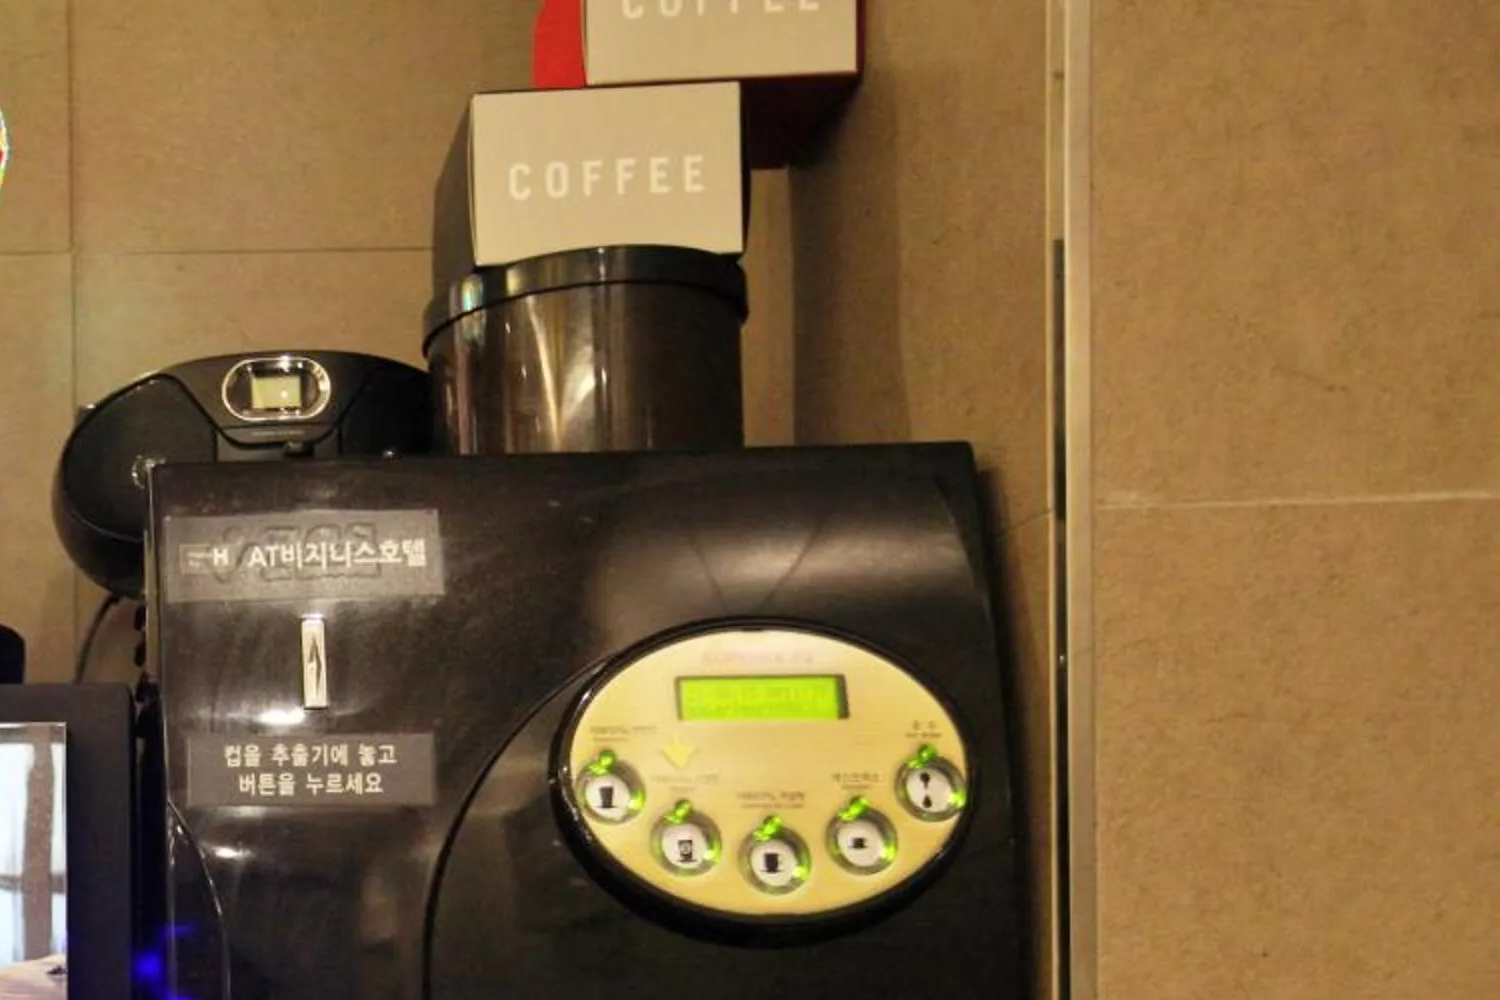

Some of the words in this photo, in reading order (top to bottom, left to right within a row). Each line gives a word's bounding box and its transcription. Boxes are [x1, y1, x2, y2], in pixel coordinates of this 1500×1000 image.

[509, 152, 706, 201] COFFEE
[248, 538, 428, 569] AT비지니스호텔
[224, 743, 261, 767] 컵을
[271, 743, 349, 768] 추출기에
[358, 743, 398, 767] 놓고
[238, 772, 296, 797] 버튼을
[305, 772, 384, 796] 누르세요
